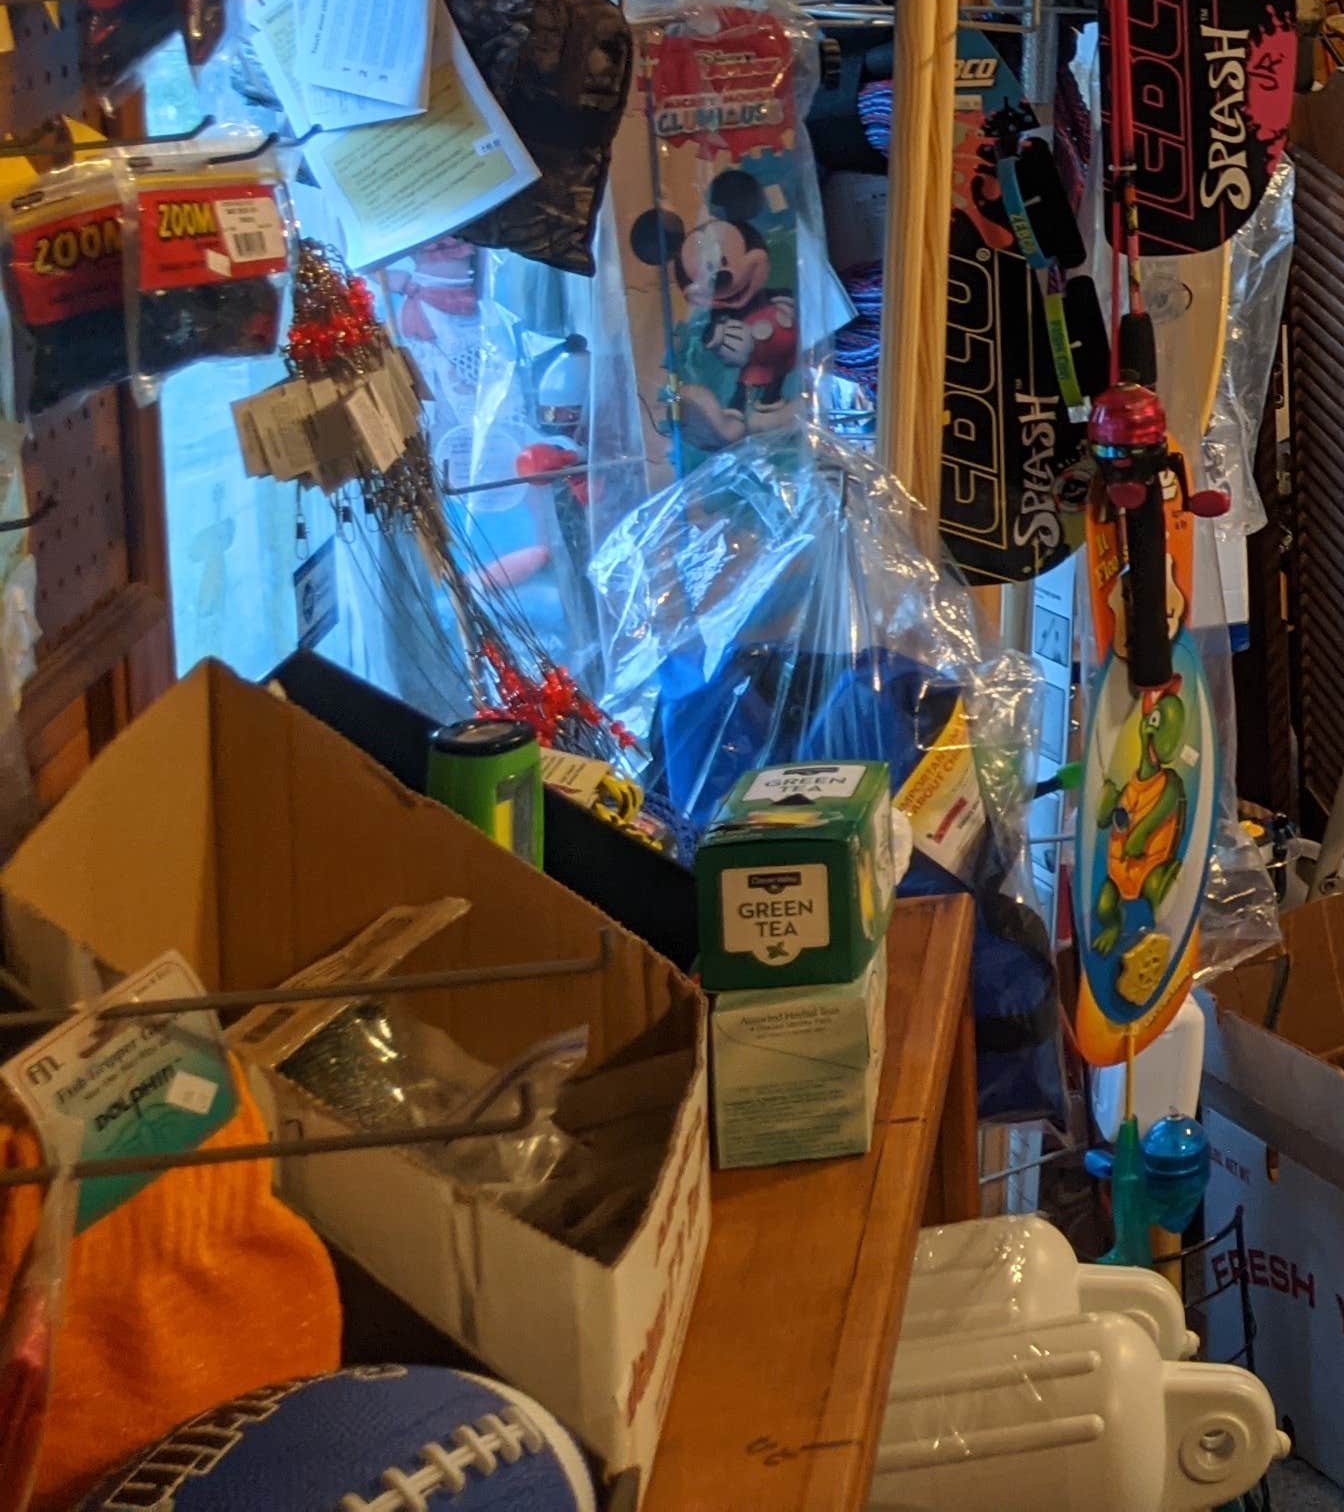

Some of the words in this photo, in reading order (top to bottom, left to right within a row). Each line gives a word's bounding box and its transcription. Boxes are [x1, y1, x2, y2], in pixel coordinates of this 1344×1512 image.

[1247, 51, 1285, 91] JR.
[1200, 25, 1250, 210] SPLASH
[158, 200, 215, 241] ZOOM
[1012, 393, 1061, 557] SPLASH
[764, 775, 848, 788] GREEN
[780, 784, 822, 794] TEA
[738, 899, 814, 920] GREEN
[754, 920, 798, 939] TEA
[1211, 1247, 1317, 1310] FRESH
